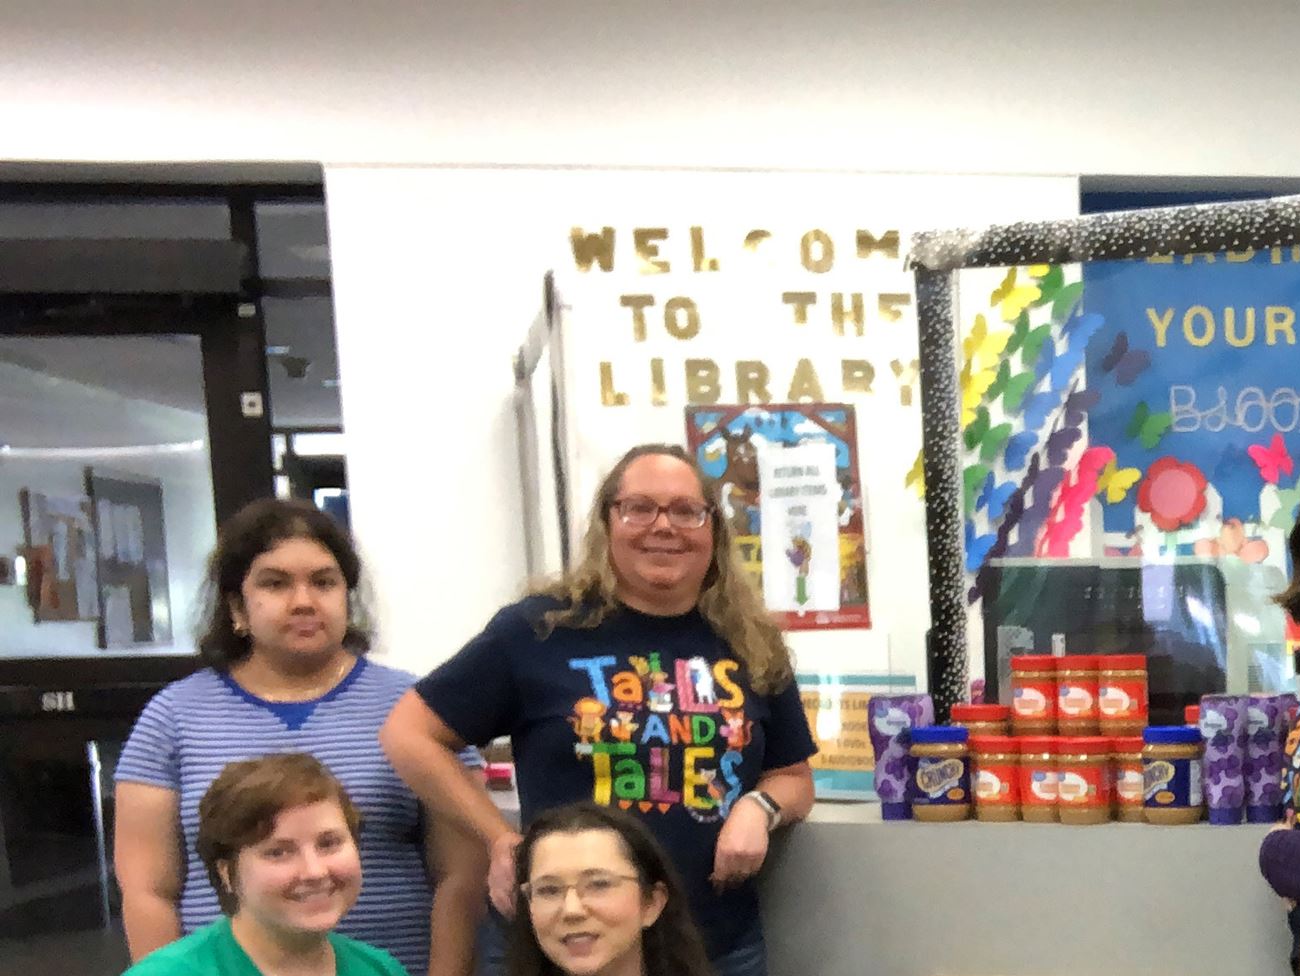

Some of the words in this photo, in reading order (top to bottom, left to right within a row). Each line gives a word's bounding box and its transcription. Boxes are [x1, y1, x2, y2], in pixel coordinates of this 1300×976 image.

[620, 293, 700, 342] TO
[1146, 305, 1296, 347] YOUR
[600, 357, 922, 406] LIBRARY
[641, 714, 716, 745] AND
